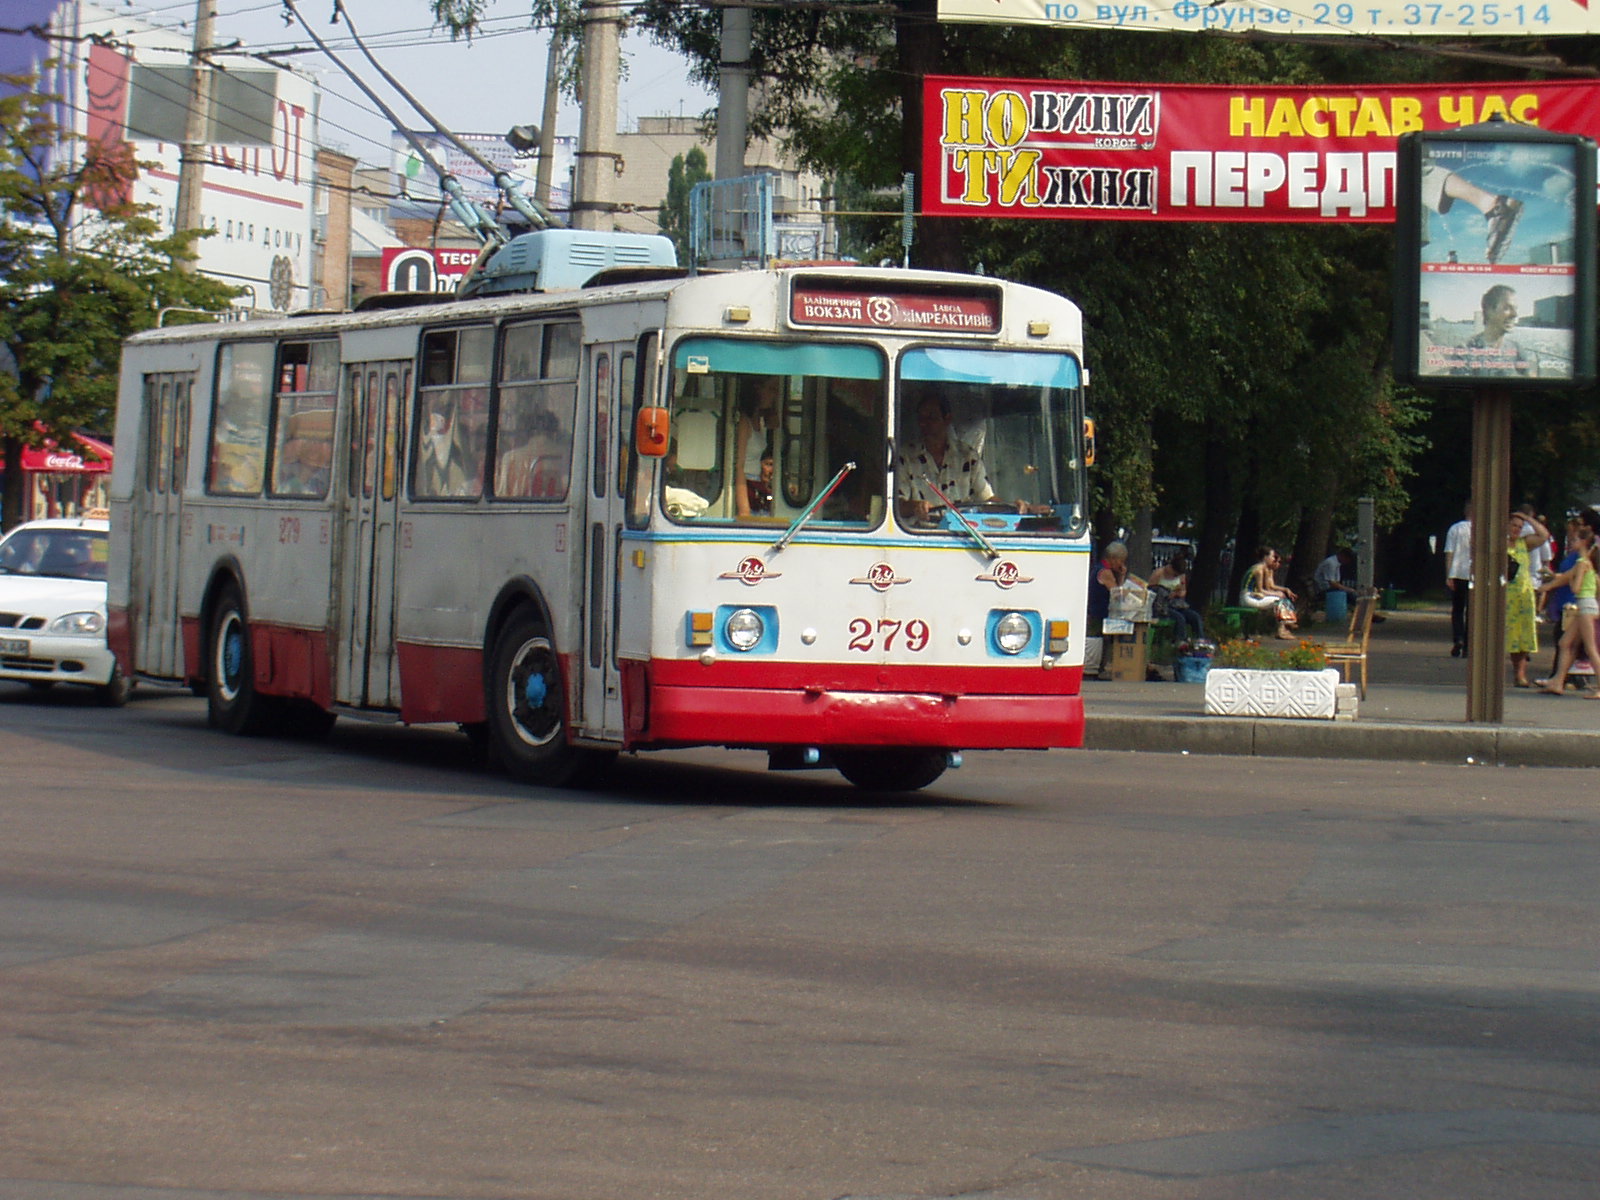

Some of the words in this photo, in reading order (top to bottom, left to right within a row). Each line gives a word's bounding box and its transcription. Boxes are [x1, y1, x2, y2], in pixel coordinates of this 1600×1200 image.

[1045, 4, 1078, 19] по
[1097, 4, 1159, 25] вул.
[1173, 0, 1304, 29] Фрунзе,
[1313, 3, 1354, 25] 29
[1367, 8, 1395, 25] т.
[1404, 3, 1551, 26] 37-25-14
[1229, 96, 1424, 138] НАСТАВ
[1438, 93, 1539, 128] ЧАС
[804, 305, 862, 320] ВОКЗАЛ
[874, 300, 892, 322] 8
[849, 618, 930, 652] 279
